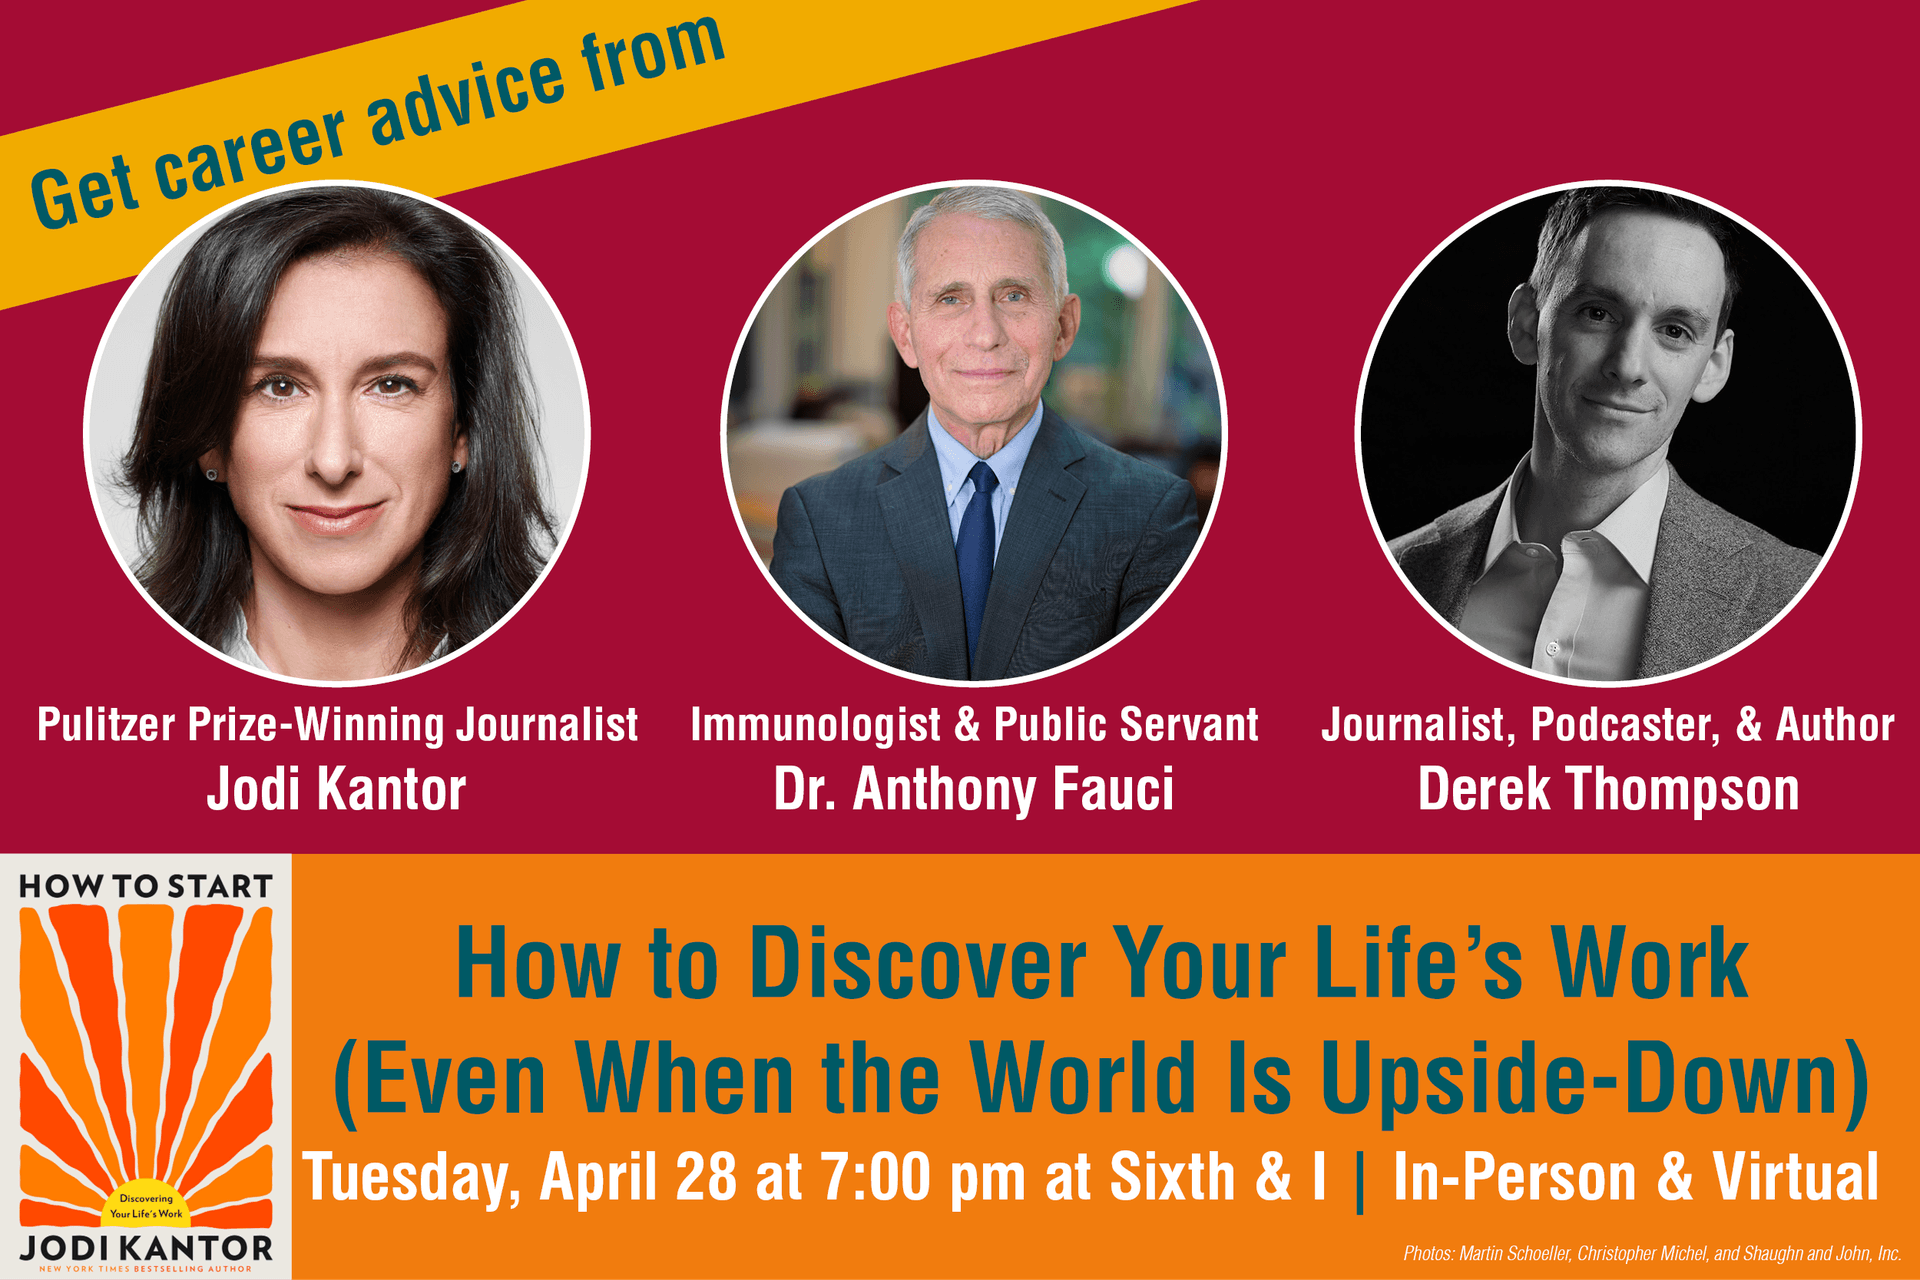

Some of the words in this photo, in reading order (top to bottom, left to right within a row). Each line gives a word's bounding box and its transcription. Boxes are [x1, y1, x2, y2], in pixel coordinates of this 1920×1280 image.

[32, 154, 139, 229] Get
[156, 111, 344, 199] career
[368, 58, 564, 145] advice
[581, 17, 724, 91] from
[39, 706, 175, 741] Pulitzer
[190, 706, 443, 749] Prize-Winning
[456, 706, 638, 741] Journalist
[693, 706, 940, 749] Immunologist
[955, 706, 980, 741] &
[996, 706, 1106, 741] Public
[1121, 706, 1258, 741] Servant
[1322, 706, 1514, 747] Journalist,
[1533, 706, 1719, 747] Podcaster,
[1737, 706, 1762, 741] &
[1776, 706, 1895, 741] Author
[207, 765, 298, 810] Jodi
[319, 765, 466, 810] Kantor
[776, 765, 834, 810] Dr.
[853, 765, 1037, 820] Anthony
[1055, 765, 1172, 810] Fauci
[1420, 765, 1551, 810] Derek
[1565, 765, 1798, 820] Thompson
[20, 874, 104, 898] HOW
[112, 874, 158, 898] TO
[168, 874, 273, 898] START
[459, 925, 621, 999] How
[649, 928, 717, 999] to
[752, 925, 1086, 999] Discover
[1113, 925, 1286, 999] Your
[1550, 925, 1749, 999] Work
[335, 1039, 543, 1132] (Even
[574, 1040, 791, 1114] When
[821, 1040, 938, 1114] the
[969, 1040, 1194, 1114] World
[1231, 1040, 1290, 1114] Is
[1323, 1039, 1867, 1132] Upside-Down)
[119, 1193, 174, 1205] Discovering
[302, 1151, 519, 1212] Tuesday,
[540, 1151, 655, 1212] April
[677, 1151, 736, 1200] 28
[757, 1153, 802, 1200] at
[821, 1151, 929, 1200] 7:00
[952, 1162, 1024, 1212] pm
[1046, 1153, 1091, 1200] at
[1111, 1150, 1234, 1200] Sixth
[1256, 1151, 1291, 1200] &
[1315, 1151, 1324, 1200] I
[1396, 1151, 1635, 1200] In-Person
[1658, 1151, 1693, 1200] &
[1713, 1151, 1877, 1200] Virtual
[109, 1209, 131, 1219] Your
[158, 1208, 183, 1219] Work
[19, 1235, 107, 1261] JODI
[120, 1235, 272, 1261] KANTOR
[39, 1265, 62, 1273] NEW
[65, 1265, 94, 1273] YORK
[98, 1265, 130, 1273] TIMES
[133, 1265, 204, 1273] BESTSELLING
[207, 1265, 252, 1273] AUTHOR
[1403, 1244, 1456, 1261] Photos:
[1459, 1244, 1504, 1261] Martin
[1506, 1244, 1572, 1264] Schoeller,
[1577, 1244, 1658, 1265] Christopher
[1660, 1244, 1710, 1264] Michel,
[1713, 1244, 1741, 1261] and
[1743, 1244, 1804, 1265] Shaughn
[1806, 1244, 1834, 1261] and
[1835, 1244, 1873, 1264] John,
[1877, 1244, 1902, 1261] Inc.
